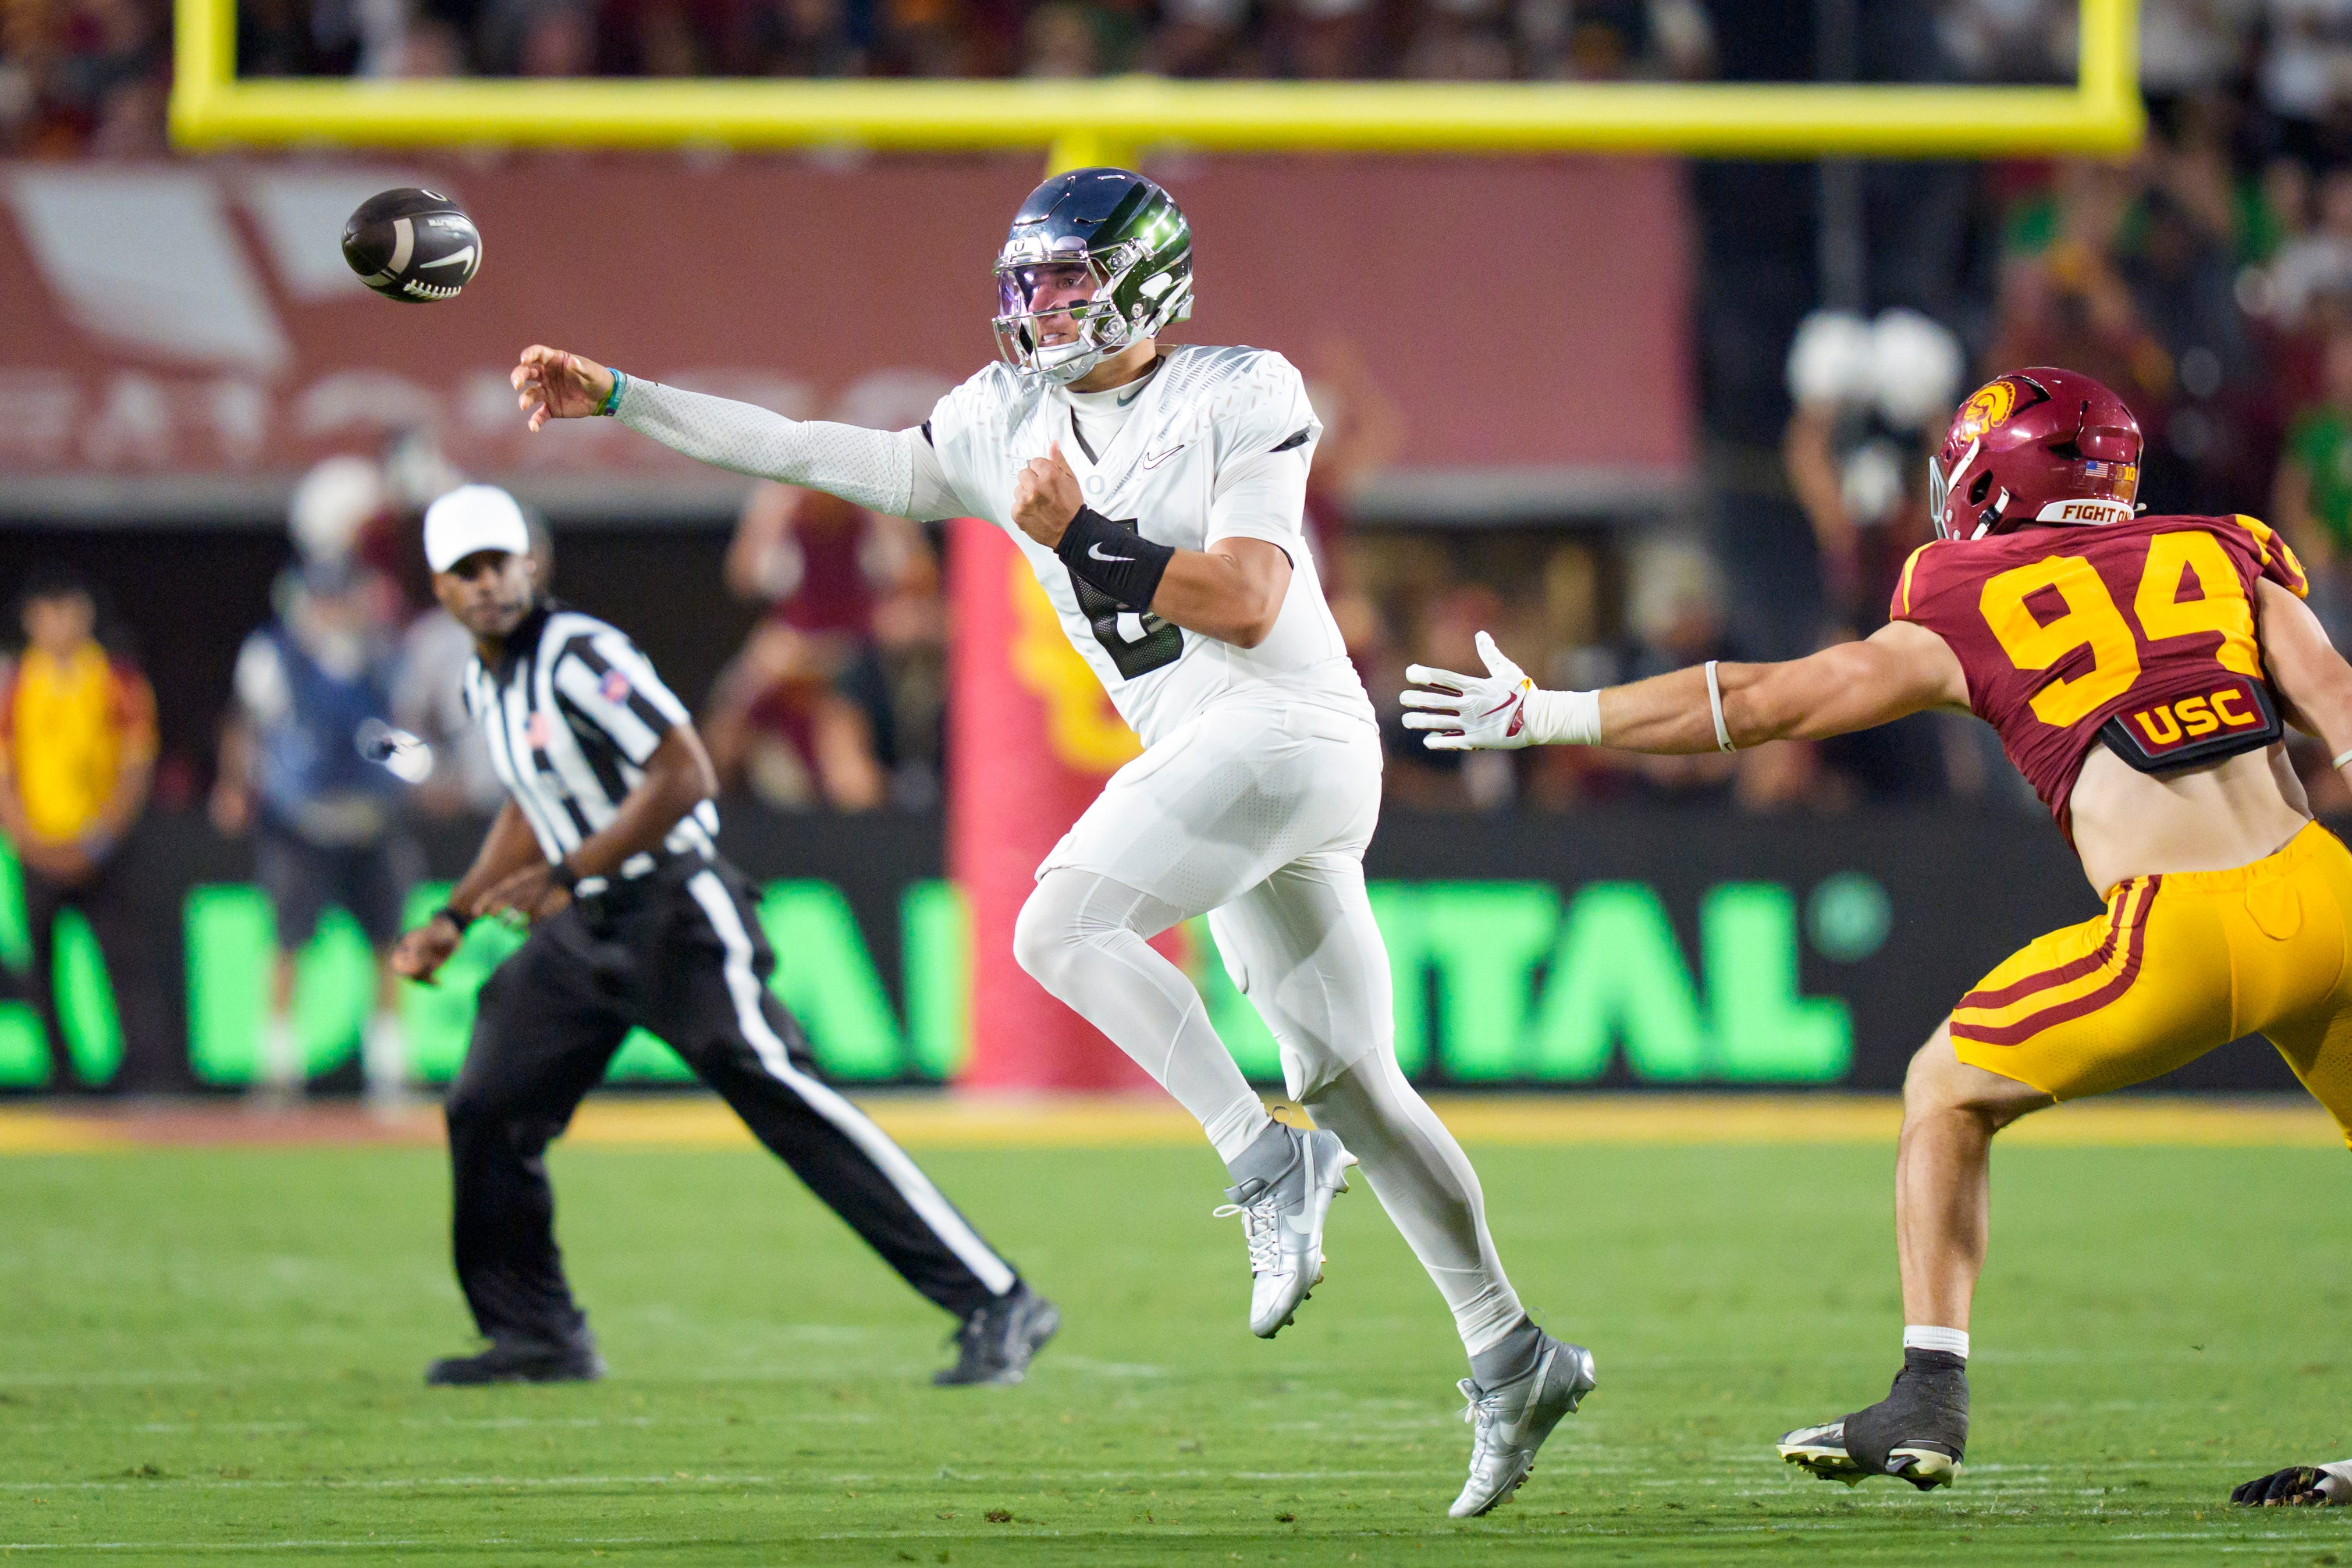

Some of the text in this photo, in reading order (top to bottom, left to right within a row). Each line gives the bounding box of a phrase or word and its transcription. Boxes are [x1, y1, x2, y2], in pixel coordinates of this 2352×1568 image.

[1085, 474, 1105, 494] O
[2062, 504, 2116, 522] FIGHT
[1978, 531, 2265, 728] 94
[2134, 688, 2257, 745] USC
